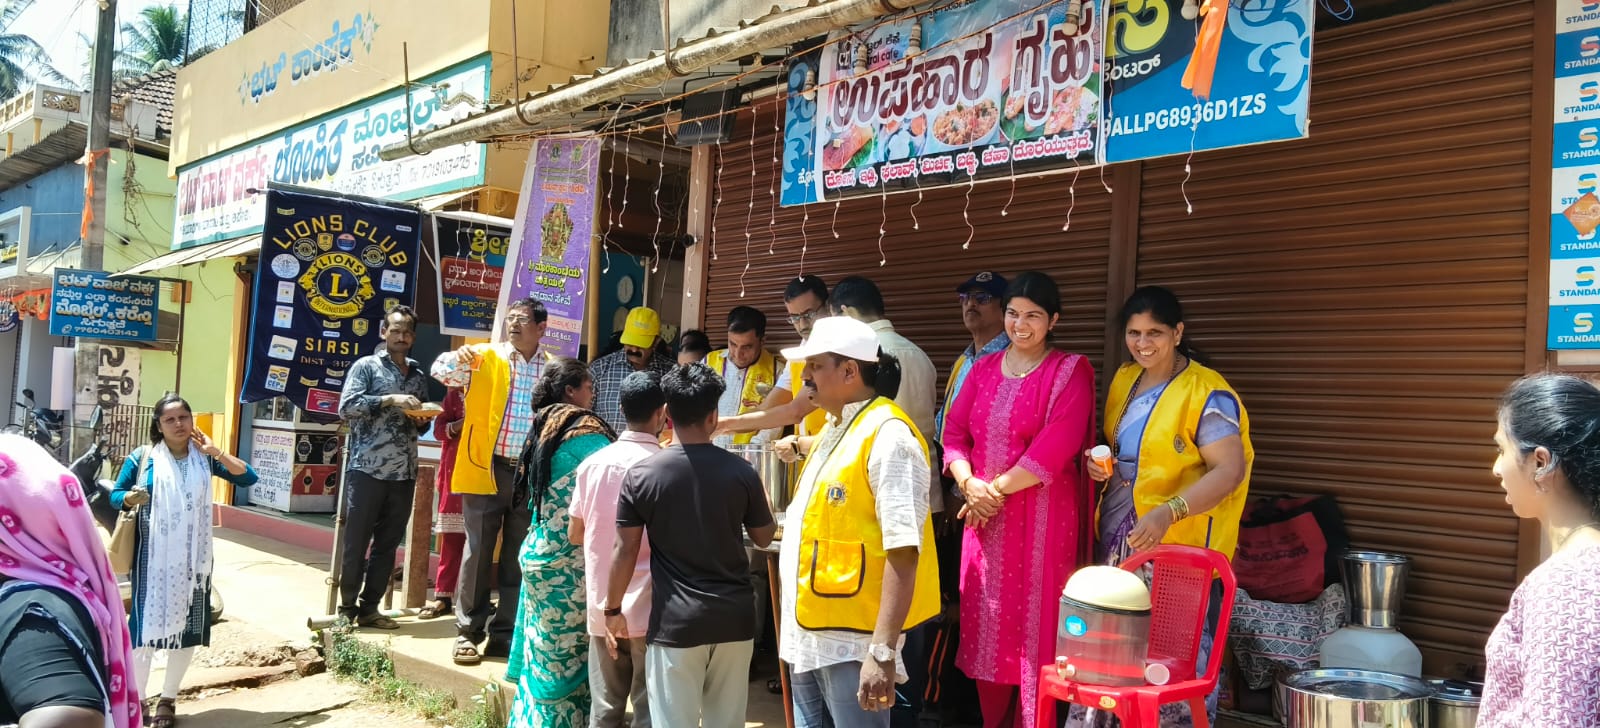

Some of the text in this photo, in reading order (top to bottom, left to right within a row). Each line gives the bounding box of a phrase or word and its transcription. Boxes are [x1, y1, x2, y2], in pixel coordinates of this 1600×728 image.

[1580, 35, 1600, 57] S
[833, 6, 1093, 127] ಉಪಹಾರ ಗೃಹ
[251, 52, 287, 104] ಭಟ್
[1579, 81, 1599, 102] S
[1578, 127, 1598, 148] S
[983, 146, 1009, 164] ಚಹಾ
[1577, 173, 1597, 194] S
[272, 214, 343, 249] LIONS
[353, 219, 408, 267] CLUB
[319, 254, 363, 274] LIONS
[58, 273, 93, 287] ಭಟ್
[92, 278, 129, 291] ವಾಚ್
[329, 273, 349, 298] L
[1575, 266, 1596, 286] S
[85, 293, 106, 302] ಎಲ್ಲಾ
[312, 298, 357, 315] INTERNATIONAL
[55, 298, 109, 320] ಮೊಬೈಲ್
[1573, 312, 1593, 333] S
[305, 337, 359, 356] SIRSI
[300, 355, 325, 366] DIST
